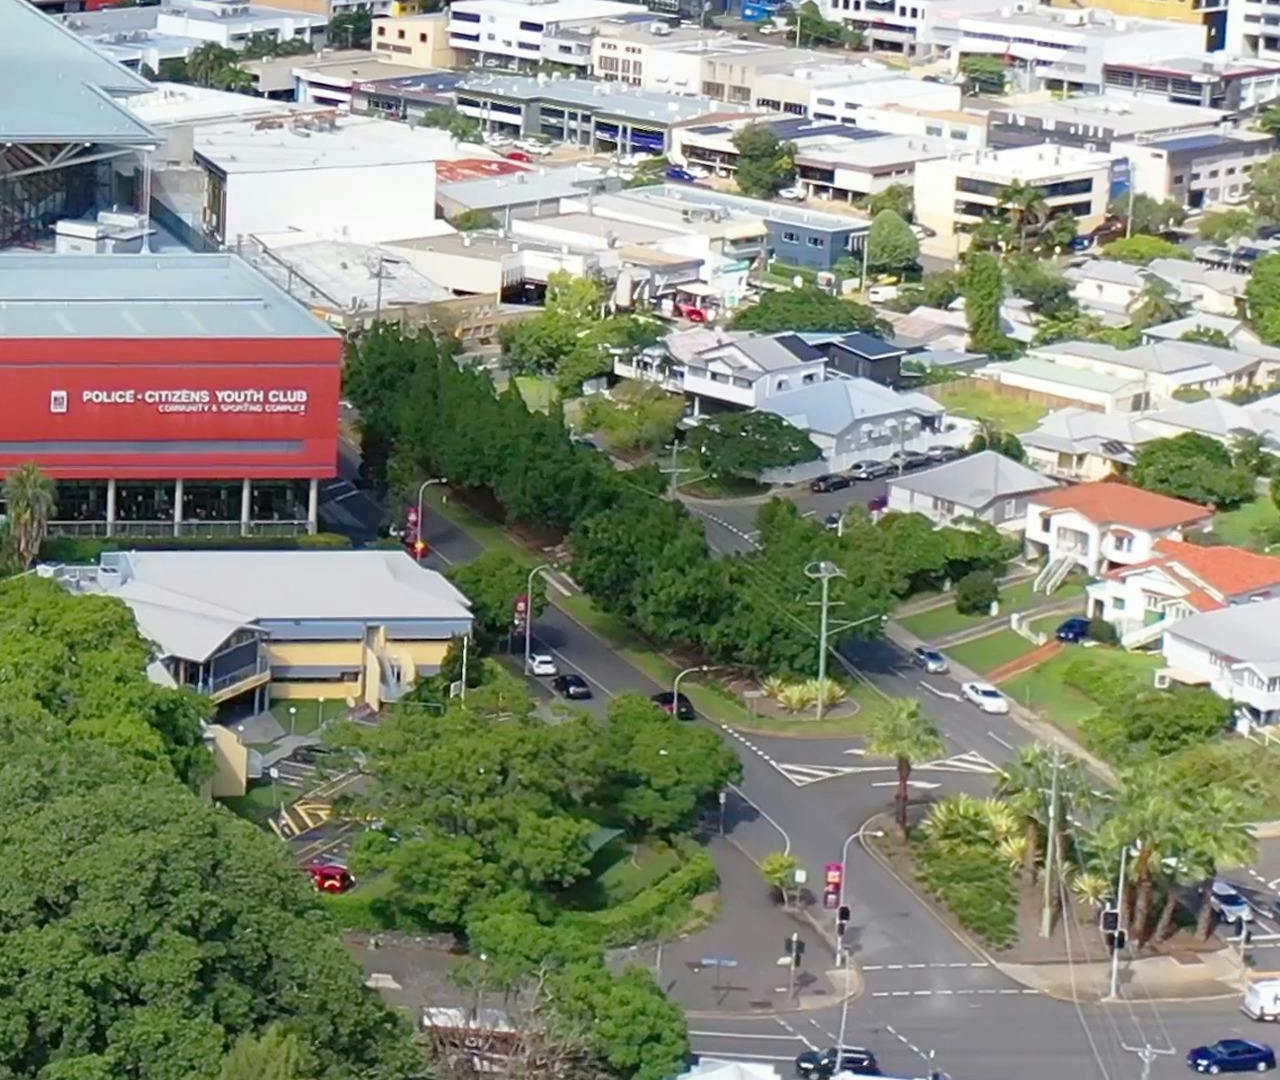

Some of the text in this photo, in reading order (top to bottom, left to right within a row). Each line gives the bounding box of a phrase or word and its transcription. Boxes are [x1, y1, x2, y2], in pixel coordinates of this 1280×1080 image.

[82, 390, 308, 403] POLICE CITIZENS YOUTH CLUB
